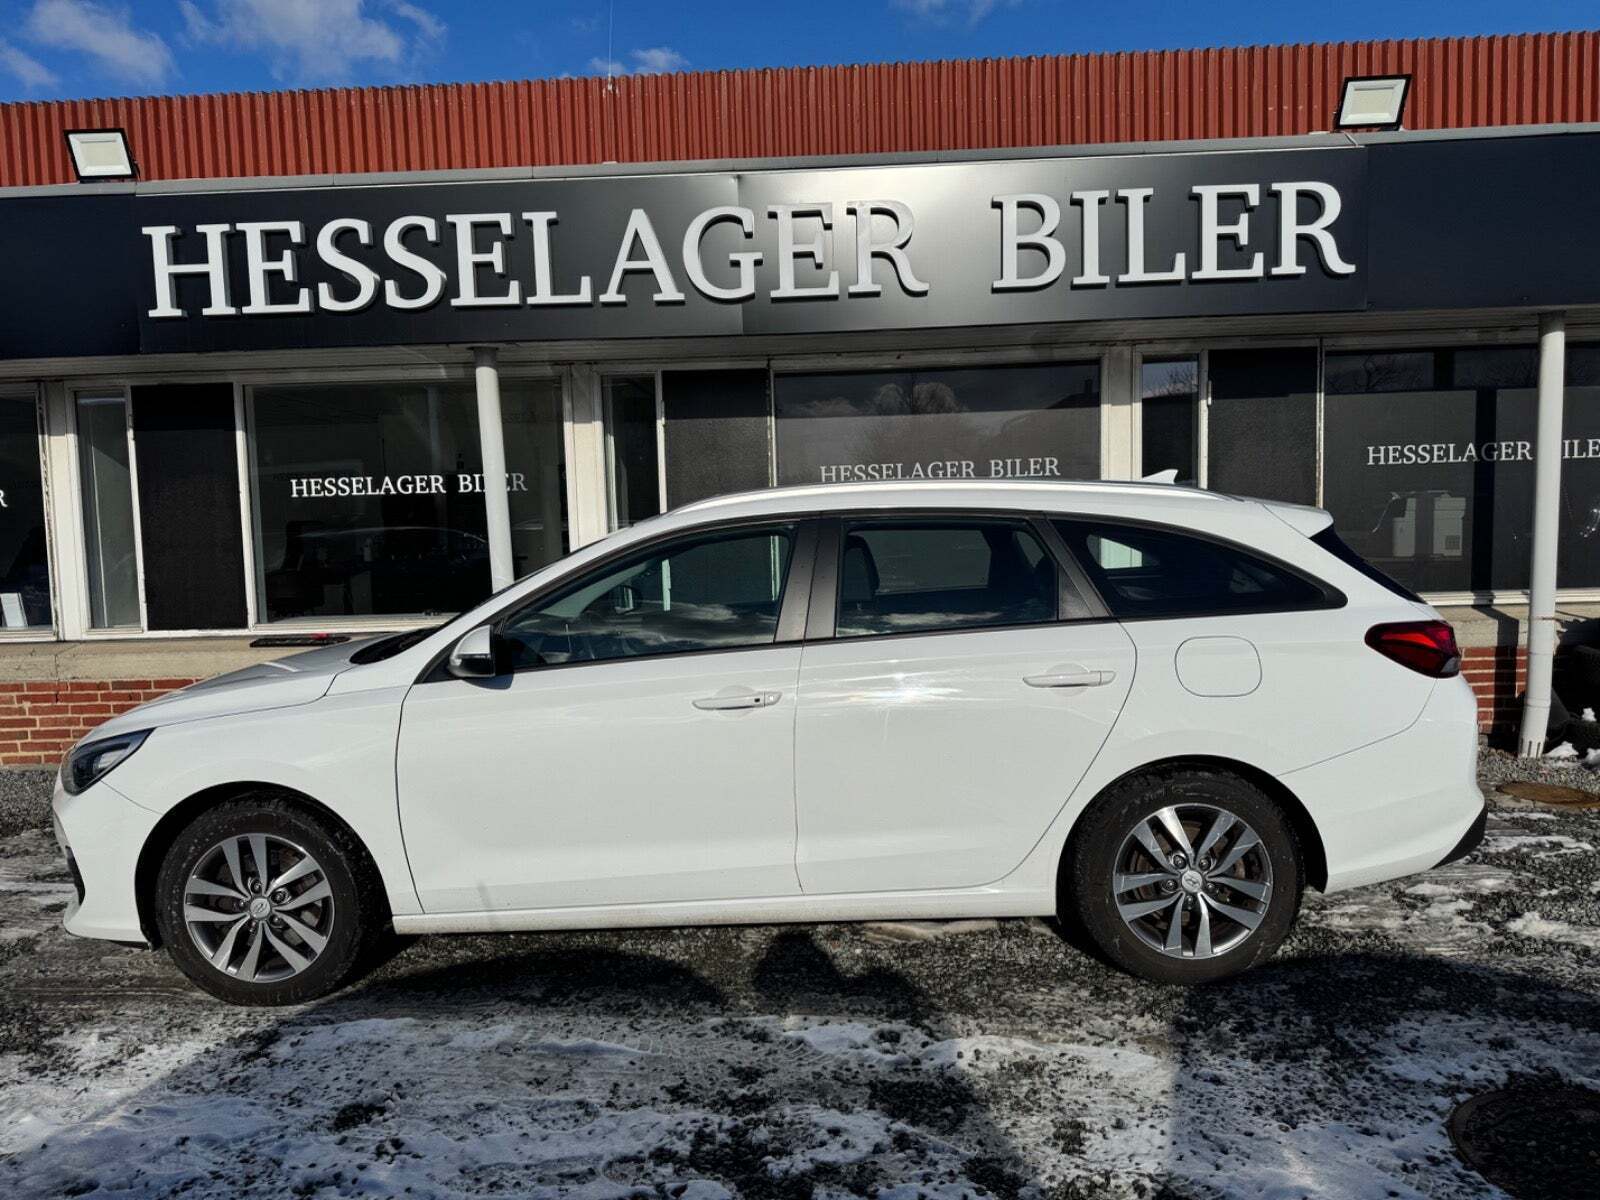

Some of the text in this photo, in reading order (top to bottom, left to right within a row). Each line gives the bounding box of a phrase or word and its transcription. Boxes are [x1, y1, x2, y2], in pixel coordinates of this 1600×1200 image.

[142, 180, 1356, 318] HESSELAGER BILER
[1366, 438, 1600, 466] HESSELAGER ILE
[819, 456, 1061, 483] HESSELAGER BILER
[290, 472, 528, 498] HESSELAGER BIR
